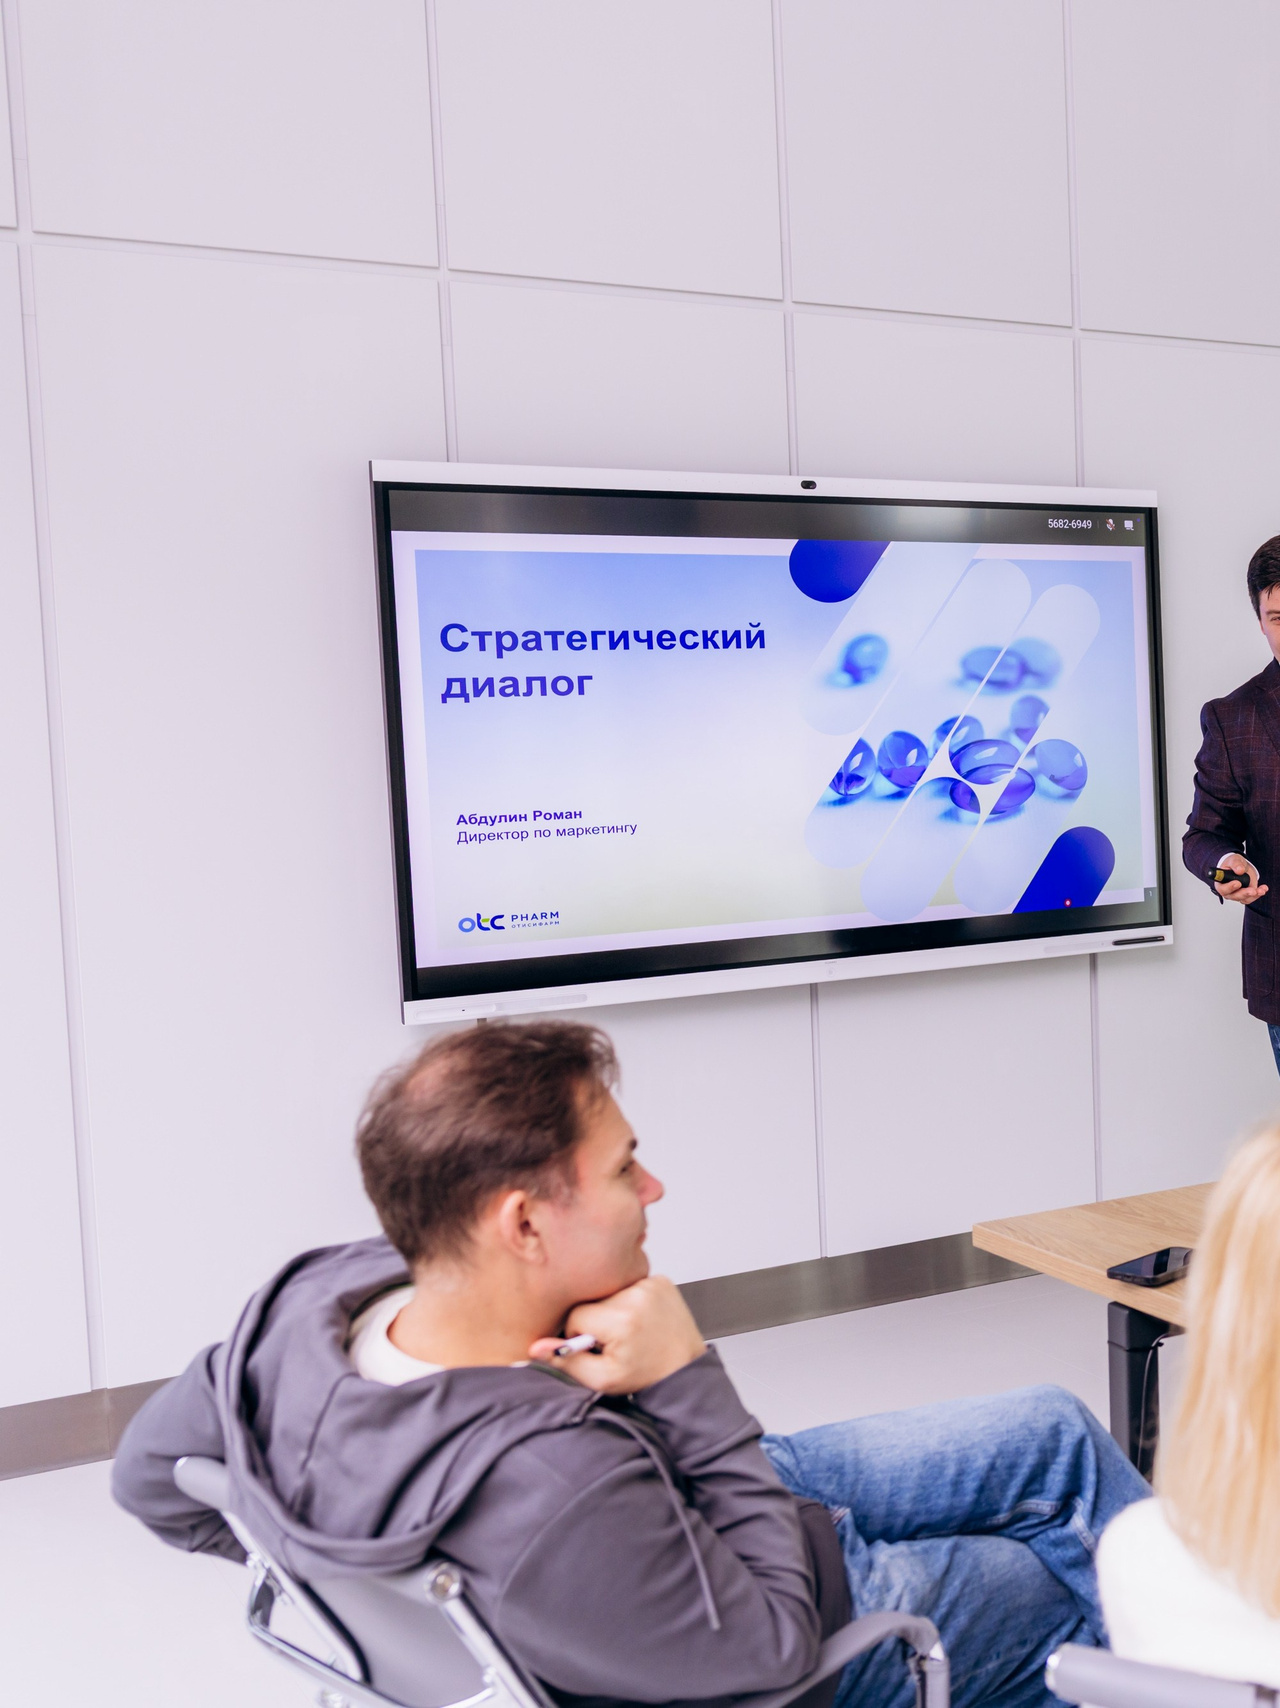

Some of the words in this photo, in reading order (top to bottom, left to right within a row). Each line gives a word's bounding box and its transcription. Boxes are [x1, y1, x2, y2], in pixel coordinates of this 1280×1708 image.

[1047, 518, 1092, 529] 5682-6949
[440, 622, 766, 659] Стратегический
[441, 674, 593, 704] диалог
[456, 813, 528, 826] Абдулин
[533, 810, 583, 821] Роман
[456, 830, 529, 845] Директор
[534, 829, 551, 838] по
[556, 823, 638, 838] маркетингу
[511, 911, 560, 922] PHARM
[511, 920, 560, 929] ОТИСИФАРМ
